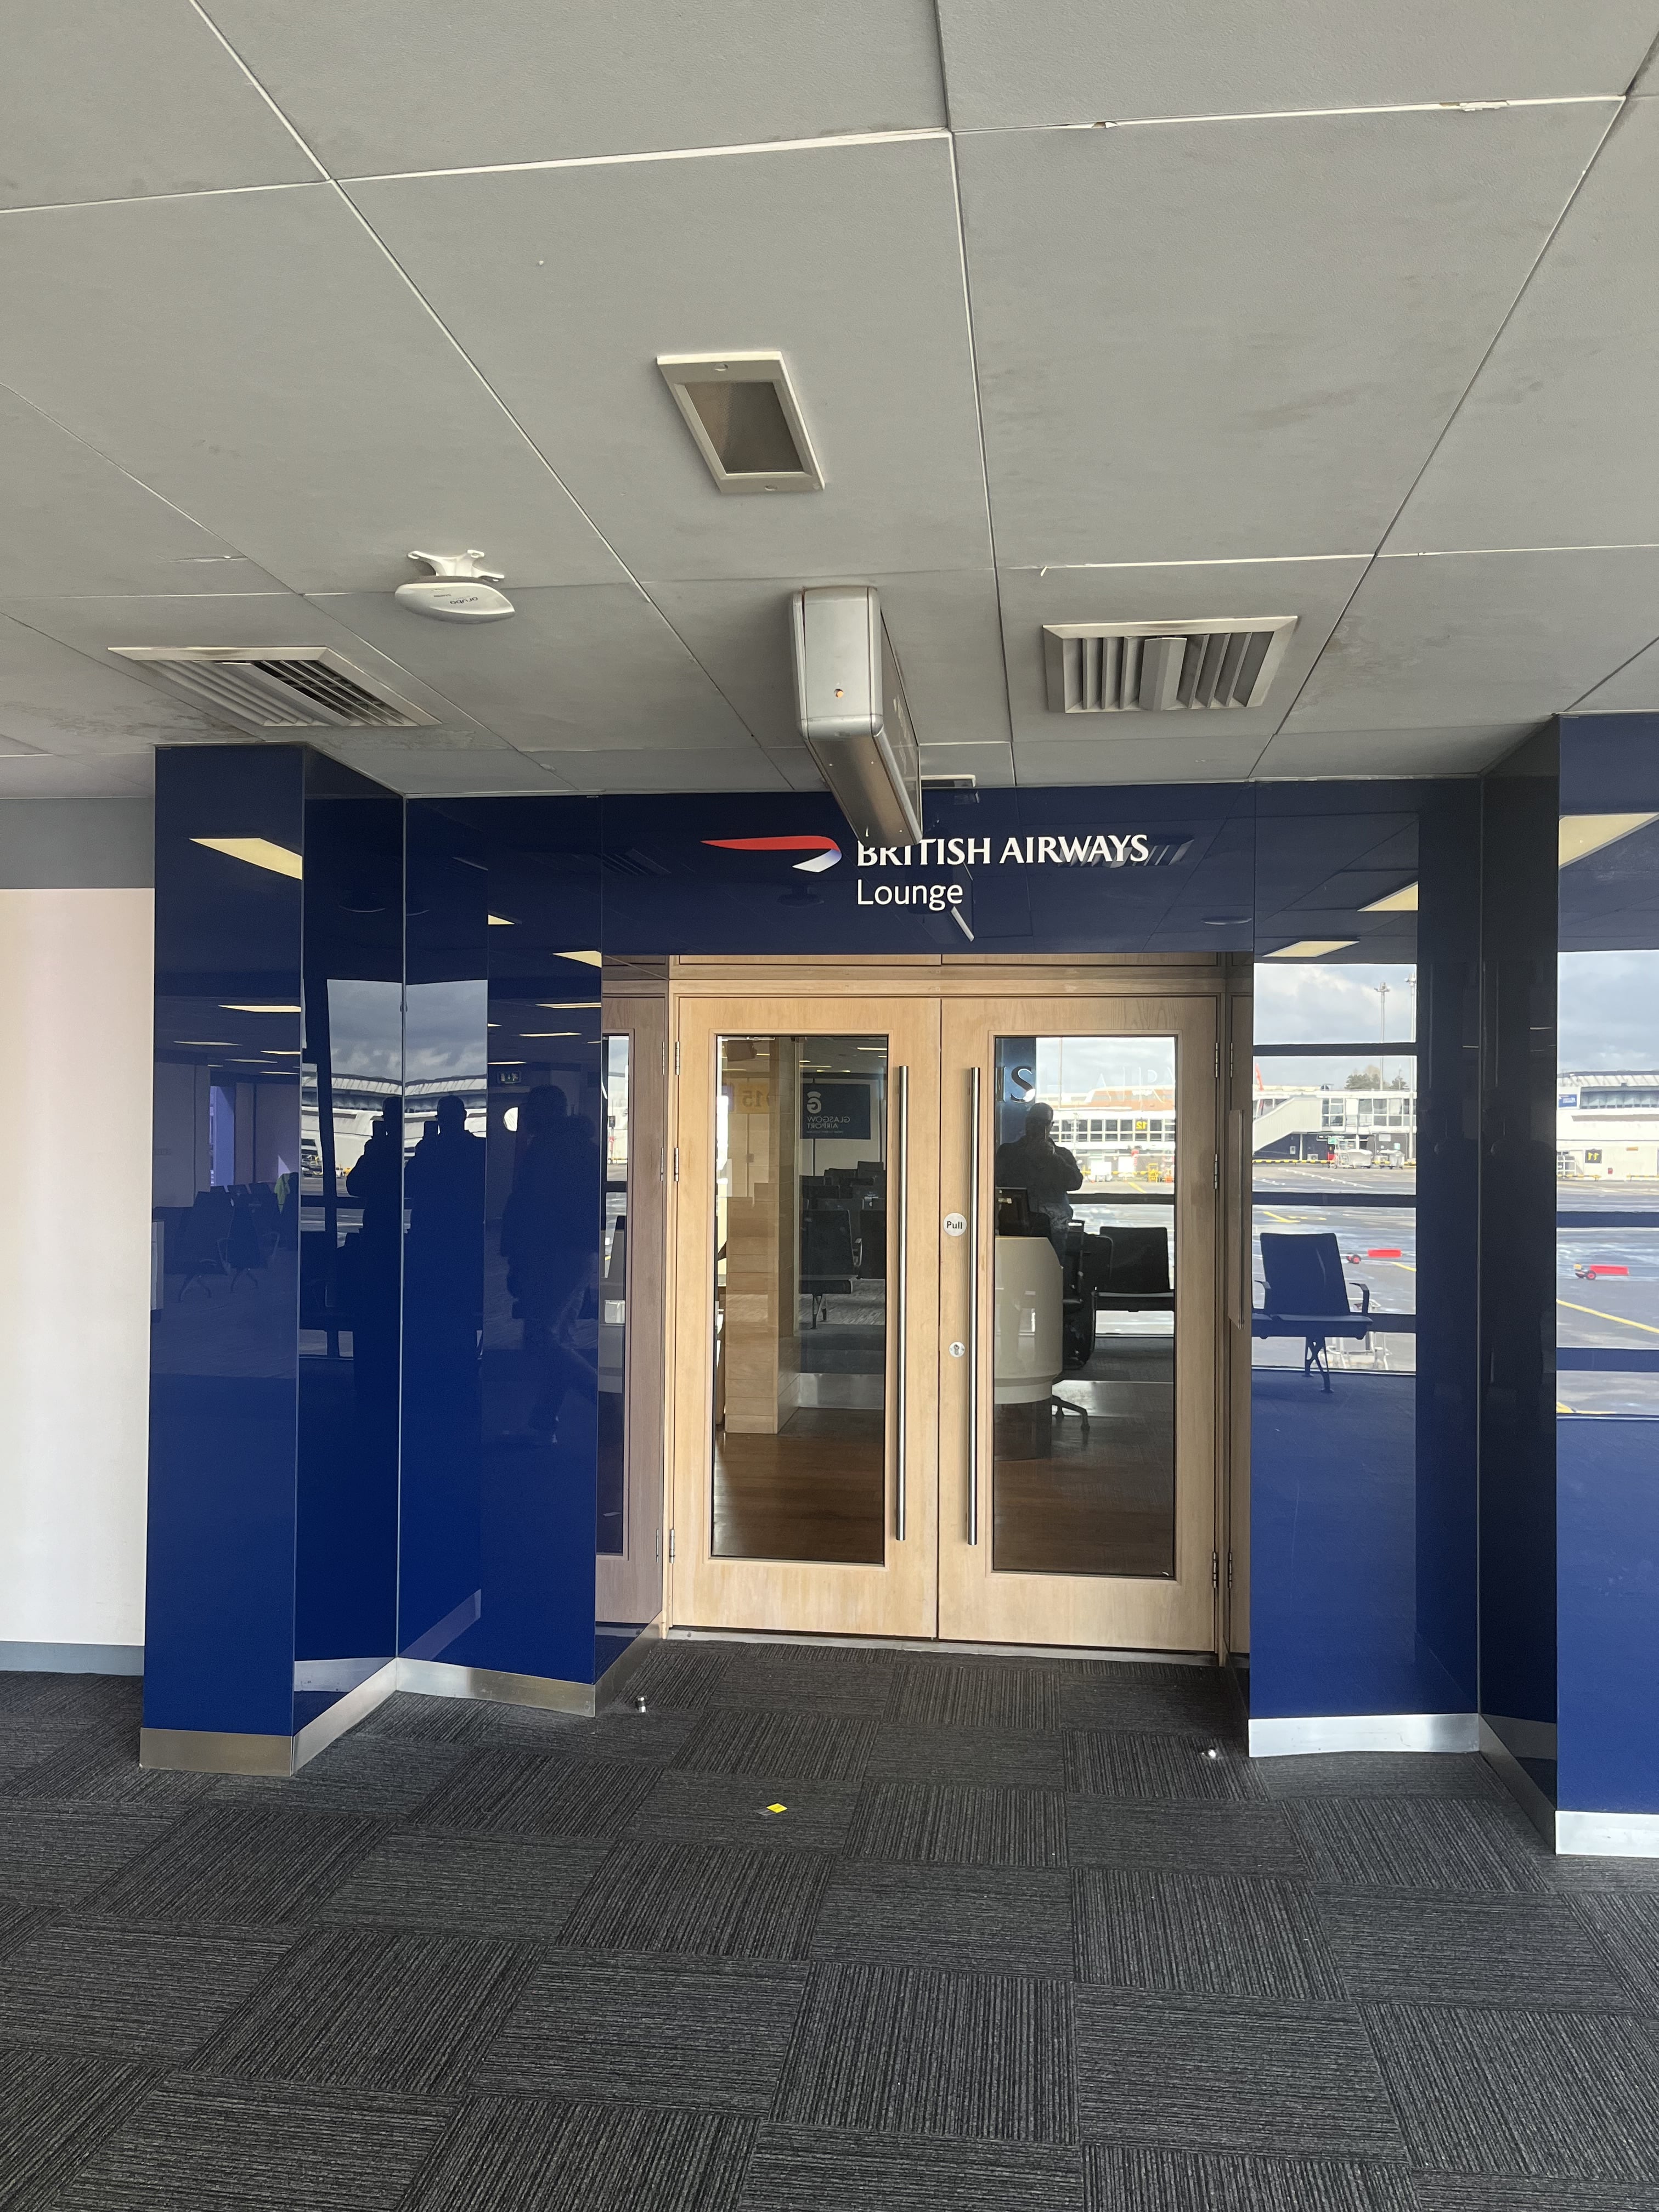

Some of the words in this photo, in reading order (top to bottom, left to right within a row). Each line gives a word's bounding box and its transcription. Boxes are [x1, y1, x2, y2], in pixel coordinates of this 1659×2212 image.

[999, 834, 1149, 864] AIRWAYS
[857, 879, 963, 911] Lounge
[946, 1221, 963, 1229] Pull
